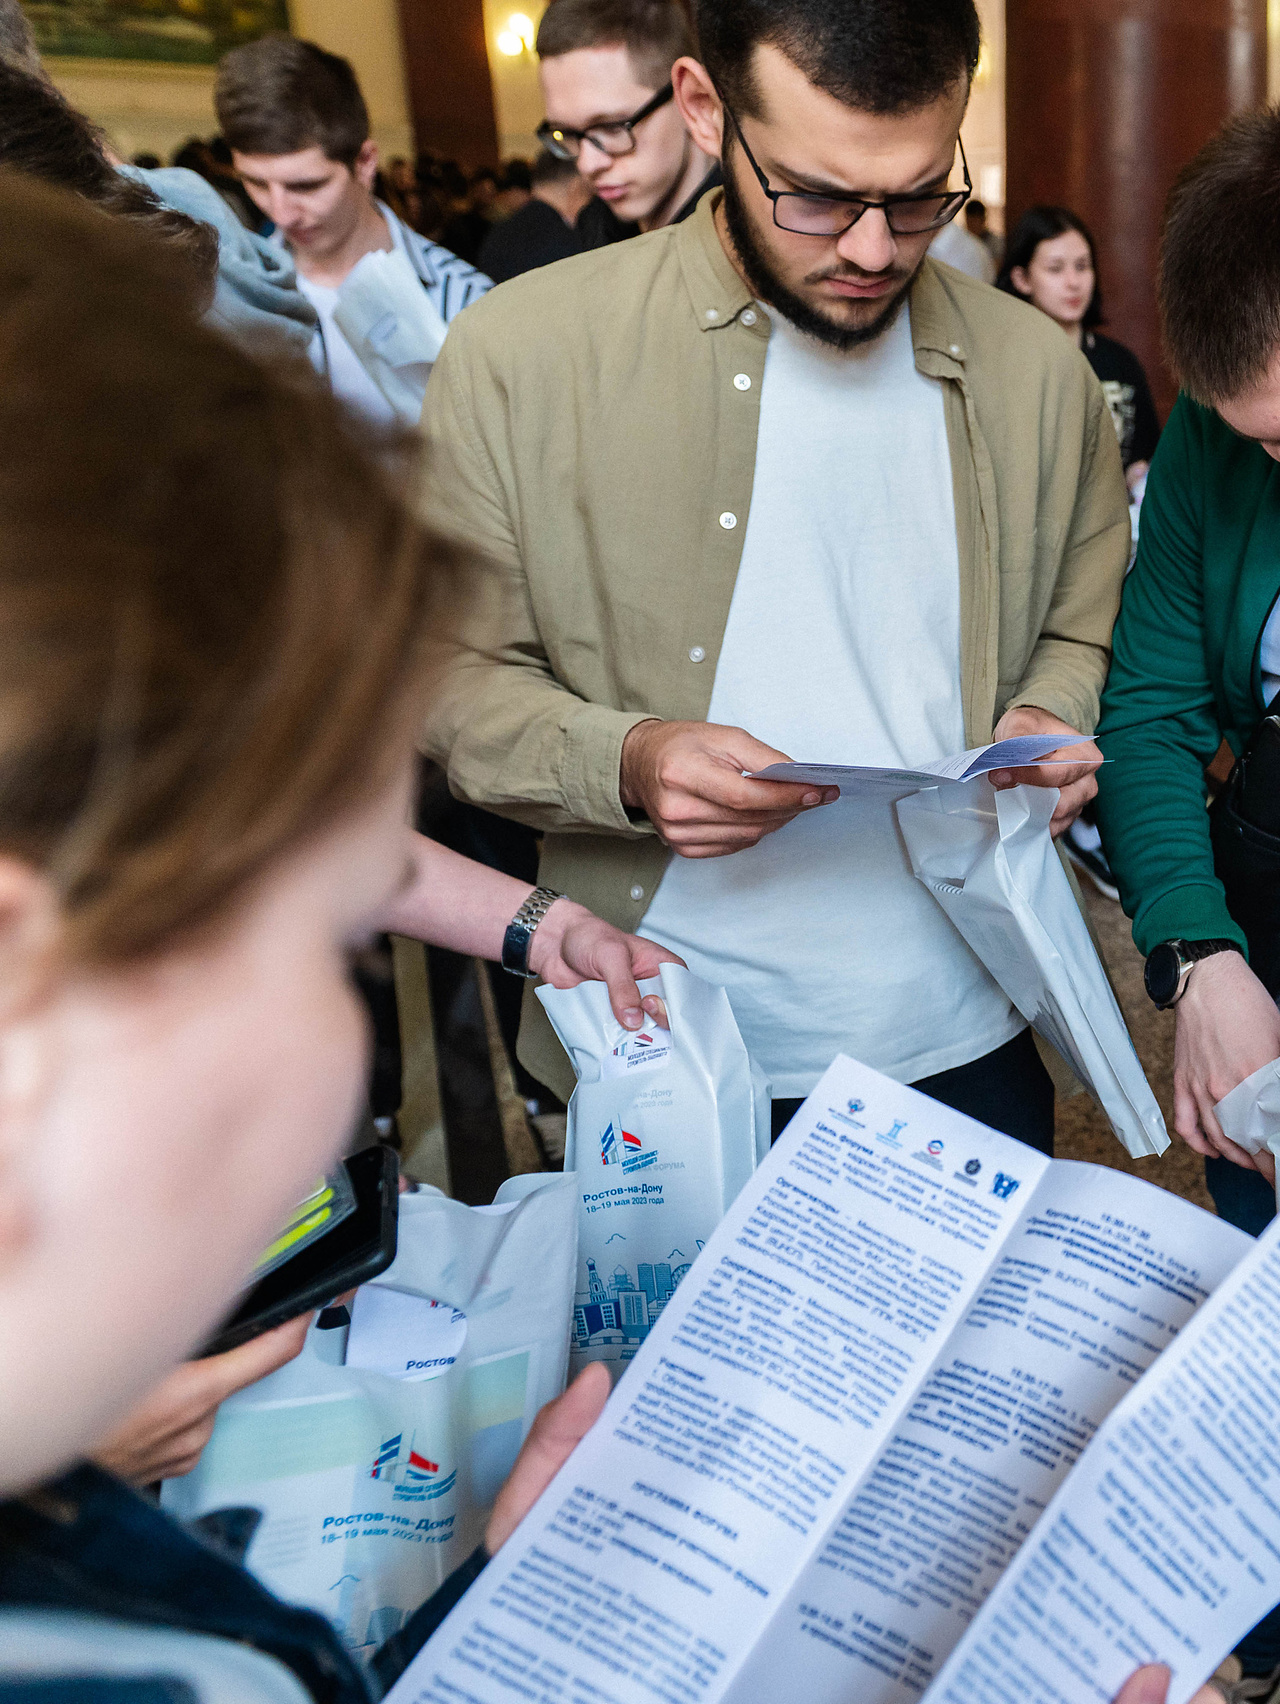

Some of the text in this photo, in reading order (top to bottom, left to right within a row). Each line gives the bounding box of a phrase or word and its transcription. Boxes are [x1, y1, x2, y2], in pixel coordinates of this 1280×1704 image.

[621, 1156, 639, 1168] МОЛОДОЙ
[582, 1183, 664, 1203] Ростов-на-Дону
[614, 1198, 631, 1207] мая
[631, 1196, 648, 1205] 2023
[648, 1197, 665, 1205] года
[322, 1511, 457, 1532] Ростов-на-Дону
[362, 1527, 389, 1537] мая
